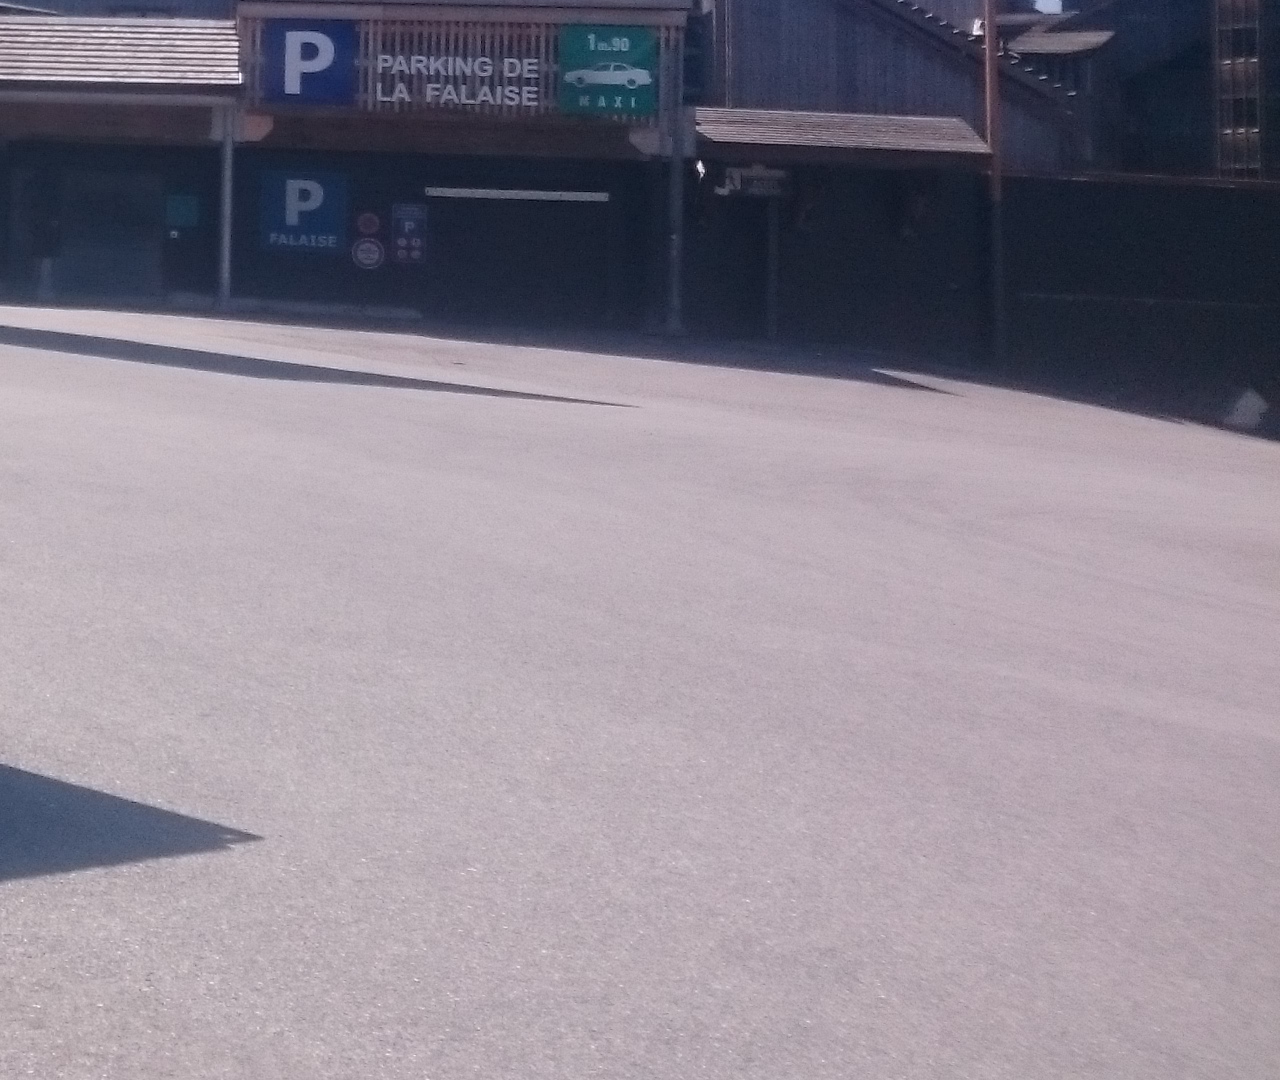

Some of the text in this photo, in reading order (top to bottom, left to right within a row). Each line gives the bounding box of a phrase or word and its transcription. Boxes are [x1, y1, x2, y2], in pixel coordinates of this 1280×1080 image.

[283, 29, 335, 96] P
[376, 54, 540, 79] PARKING DE
[376, 83, 540, 107] LA FALAISE
[578, 95, 637, 109] MAXI
[285, 179, 324, 227] P
[269, 232, 338, 248] FALAISE
